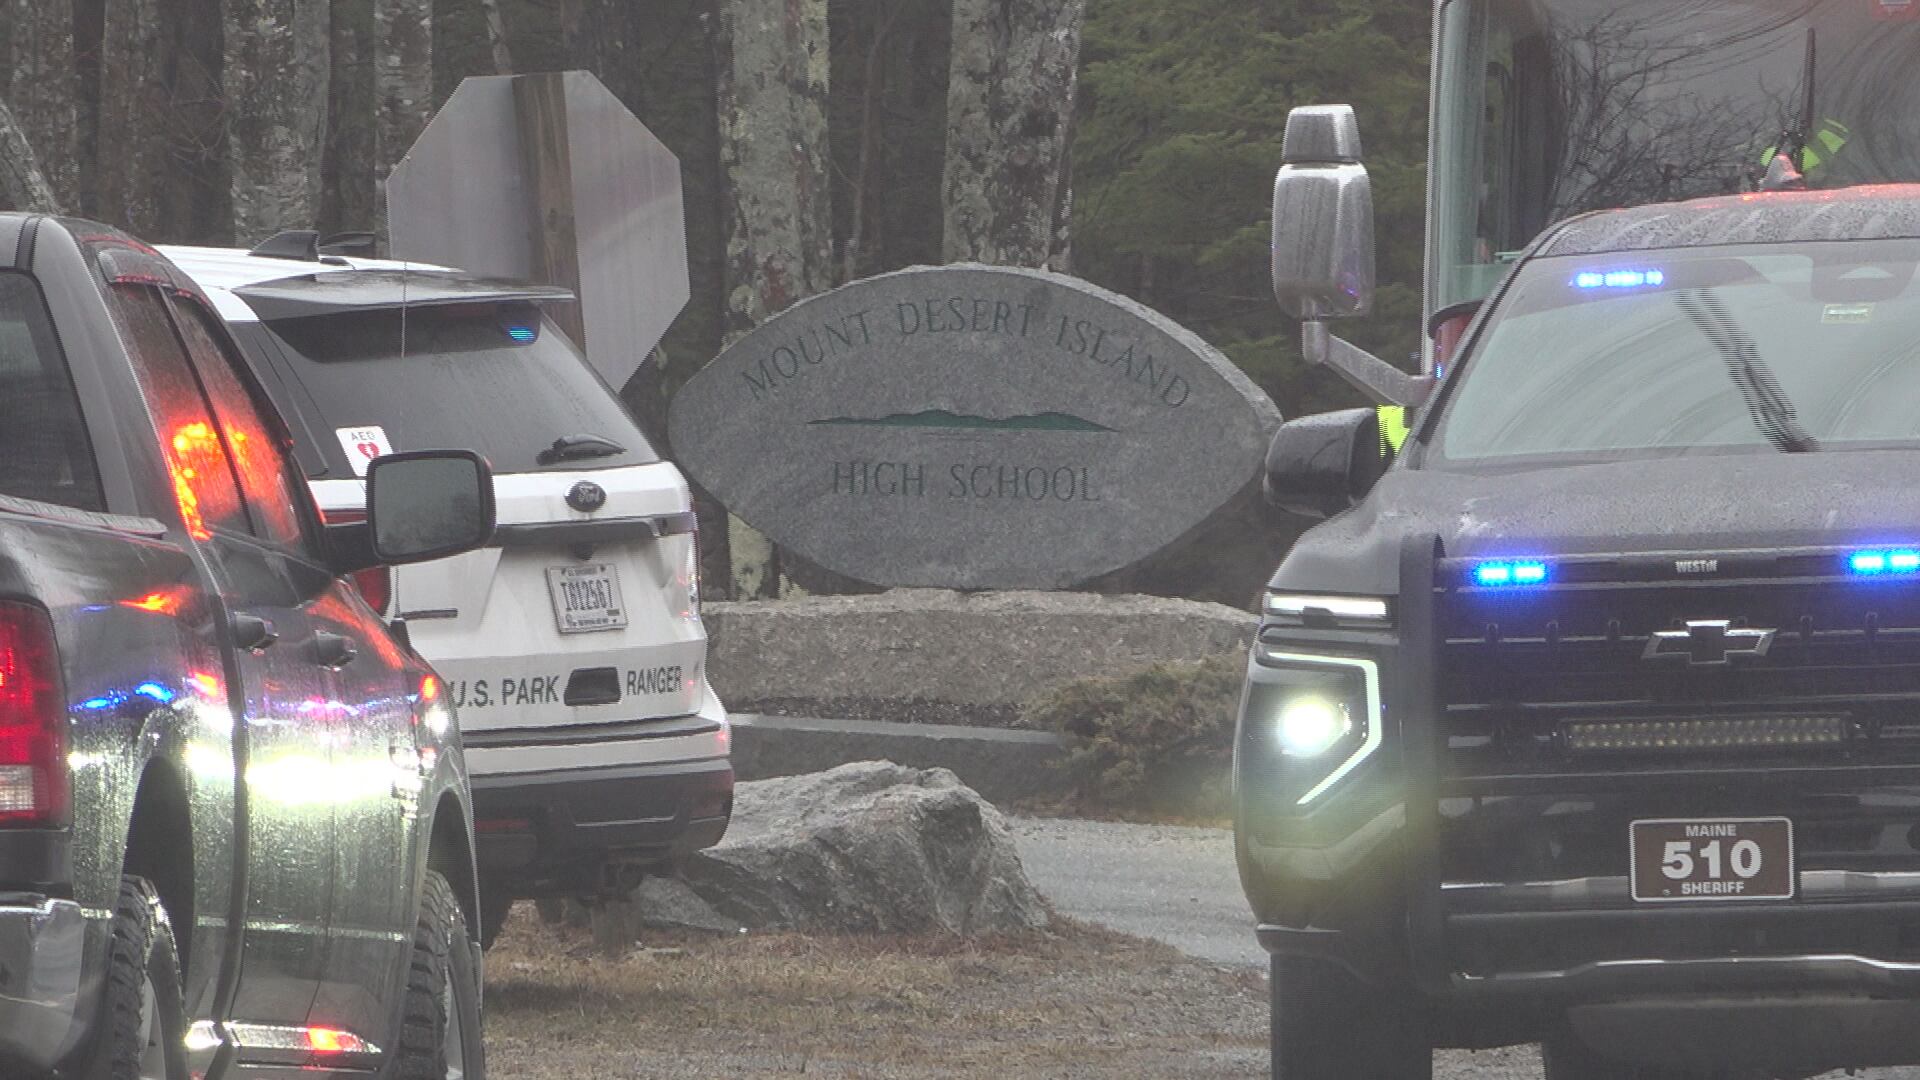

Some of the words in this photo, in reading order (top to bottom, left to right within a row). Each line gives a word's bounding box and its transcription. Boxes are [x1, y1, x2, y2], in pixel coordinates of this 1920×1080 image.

[743, 310, 871, 401] MOUNT
[898, 297, 1034, 336] DESERT
[1055, 315, 1191, 409] ISLAND
[351, 431, 376, 441] AED
[832, 461, 924, 497] HIGH
[950, 463, 1100, 501] SCHOOL
[449, 679, 494, 708] U.S.
[502, 675, 560, 706] PARK
[626, 665, 682, 696] RANGER
[1685, 824, 1737, 837] MAINE
[1661, 839, 1762, 879] 510
[1681, 881, 1745, 895] SHERIFF
